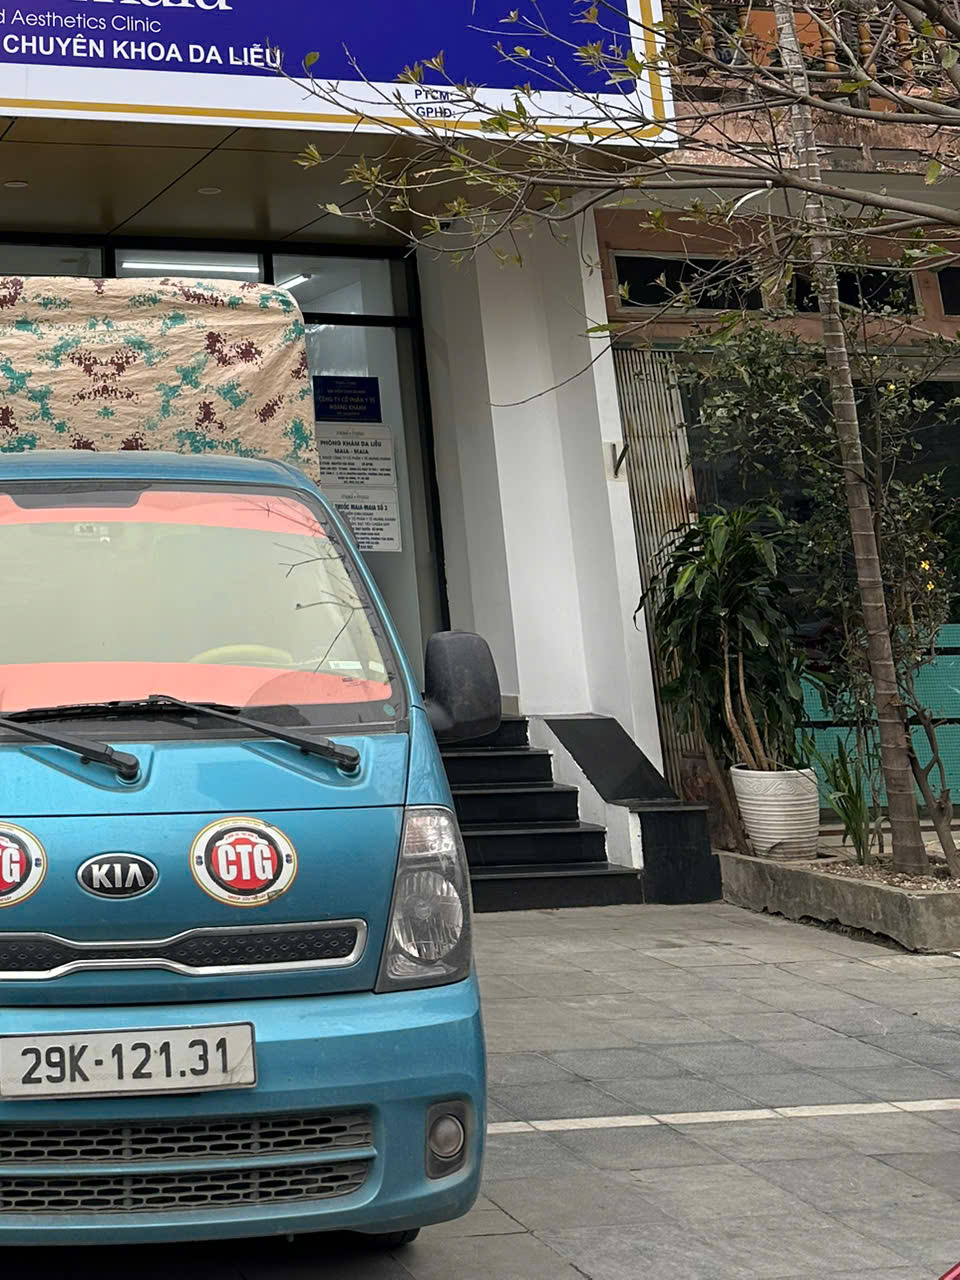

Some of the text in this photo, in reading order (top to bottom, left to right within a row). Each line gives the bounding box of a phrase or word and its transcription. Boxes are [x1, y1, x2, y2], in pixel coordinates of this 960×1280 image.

[11, 8, 107, 31] Aesthetics
[111, 15, 162, 34] Clinic
[2, 33, 105, 59] CHUYÊN
[112, 40, 183, 64] KHOA
[189, 44, 223, 65] DA
[228, 43, 282, 68] LIỄU
[91, 862, 146, 888] KIA
[217, 843, 274, 881] CTG
[21, 1037, 230, 1085] 29K-121.31
